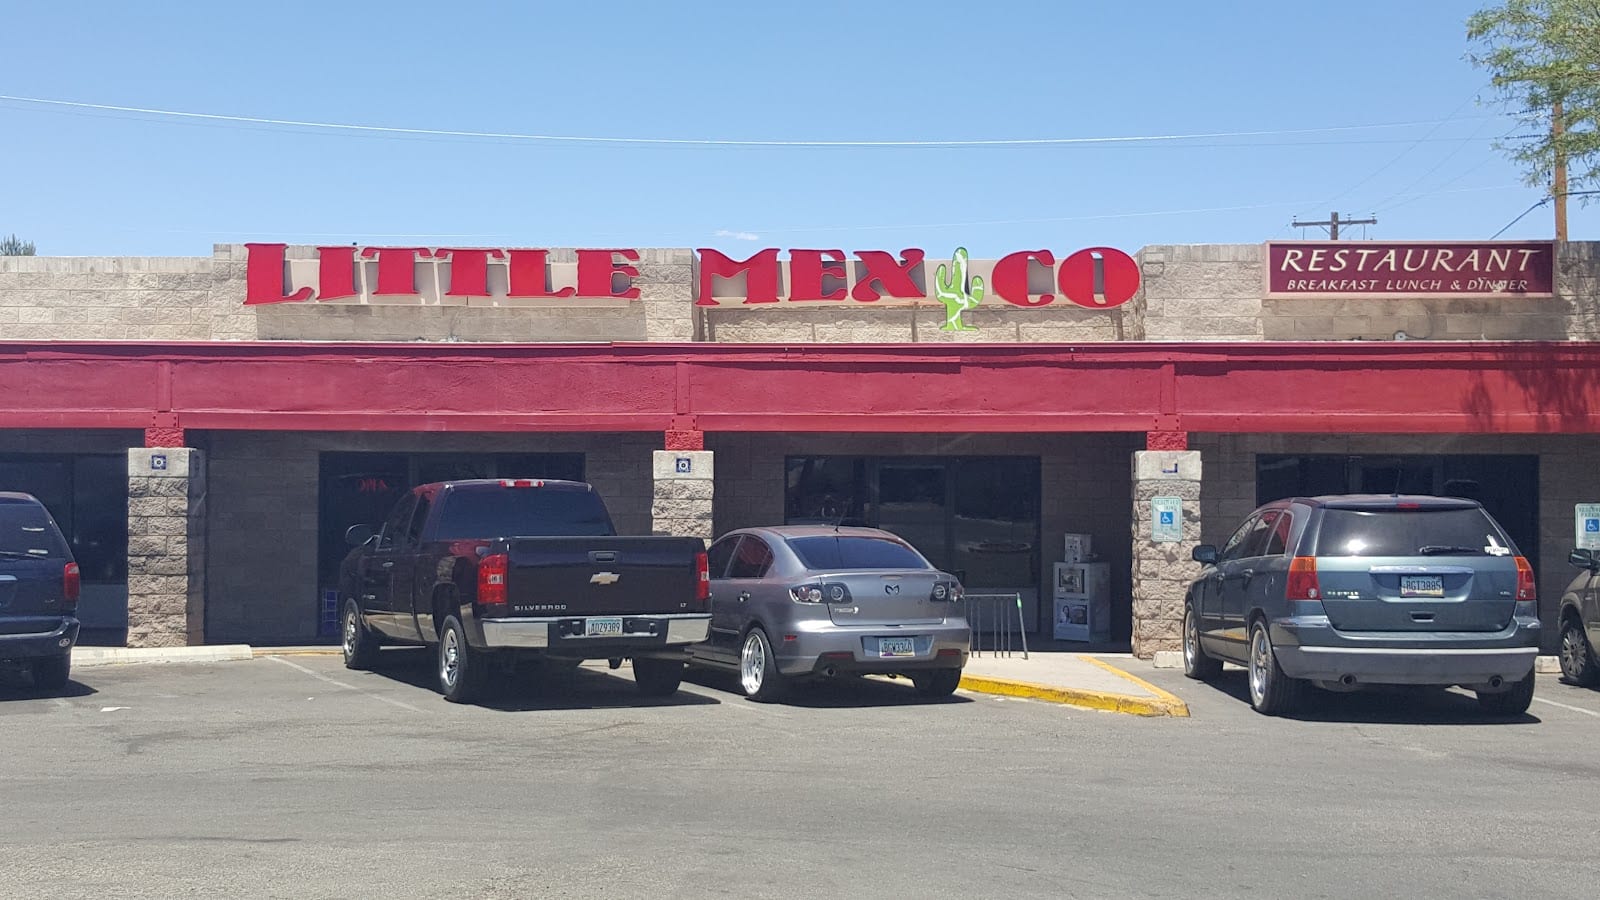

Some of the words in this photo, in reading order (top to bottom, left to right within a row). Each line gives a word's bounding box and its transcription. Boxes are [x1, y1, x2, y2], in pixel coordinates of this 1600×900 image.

[1280, 248, 1542, 272] RESTAURANT
[243, 242, 641, 305] LITTLE
[1286, 279, 1379, 291] BREAKFAST
[1385, 279, 1442, 291] LUNCH
[1450, 279, 1462, 290] &
[1467, 279, 1528, 291] DINNER
